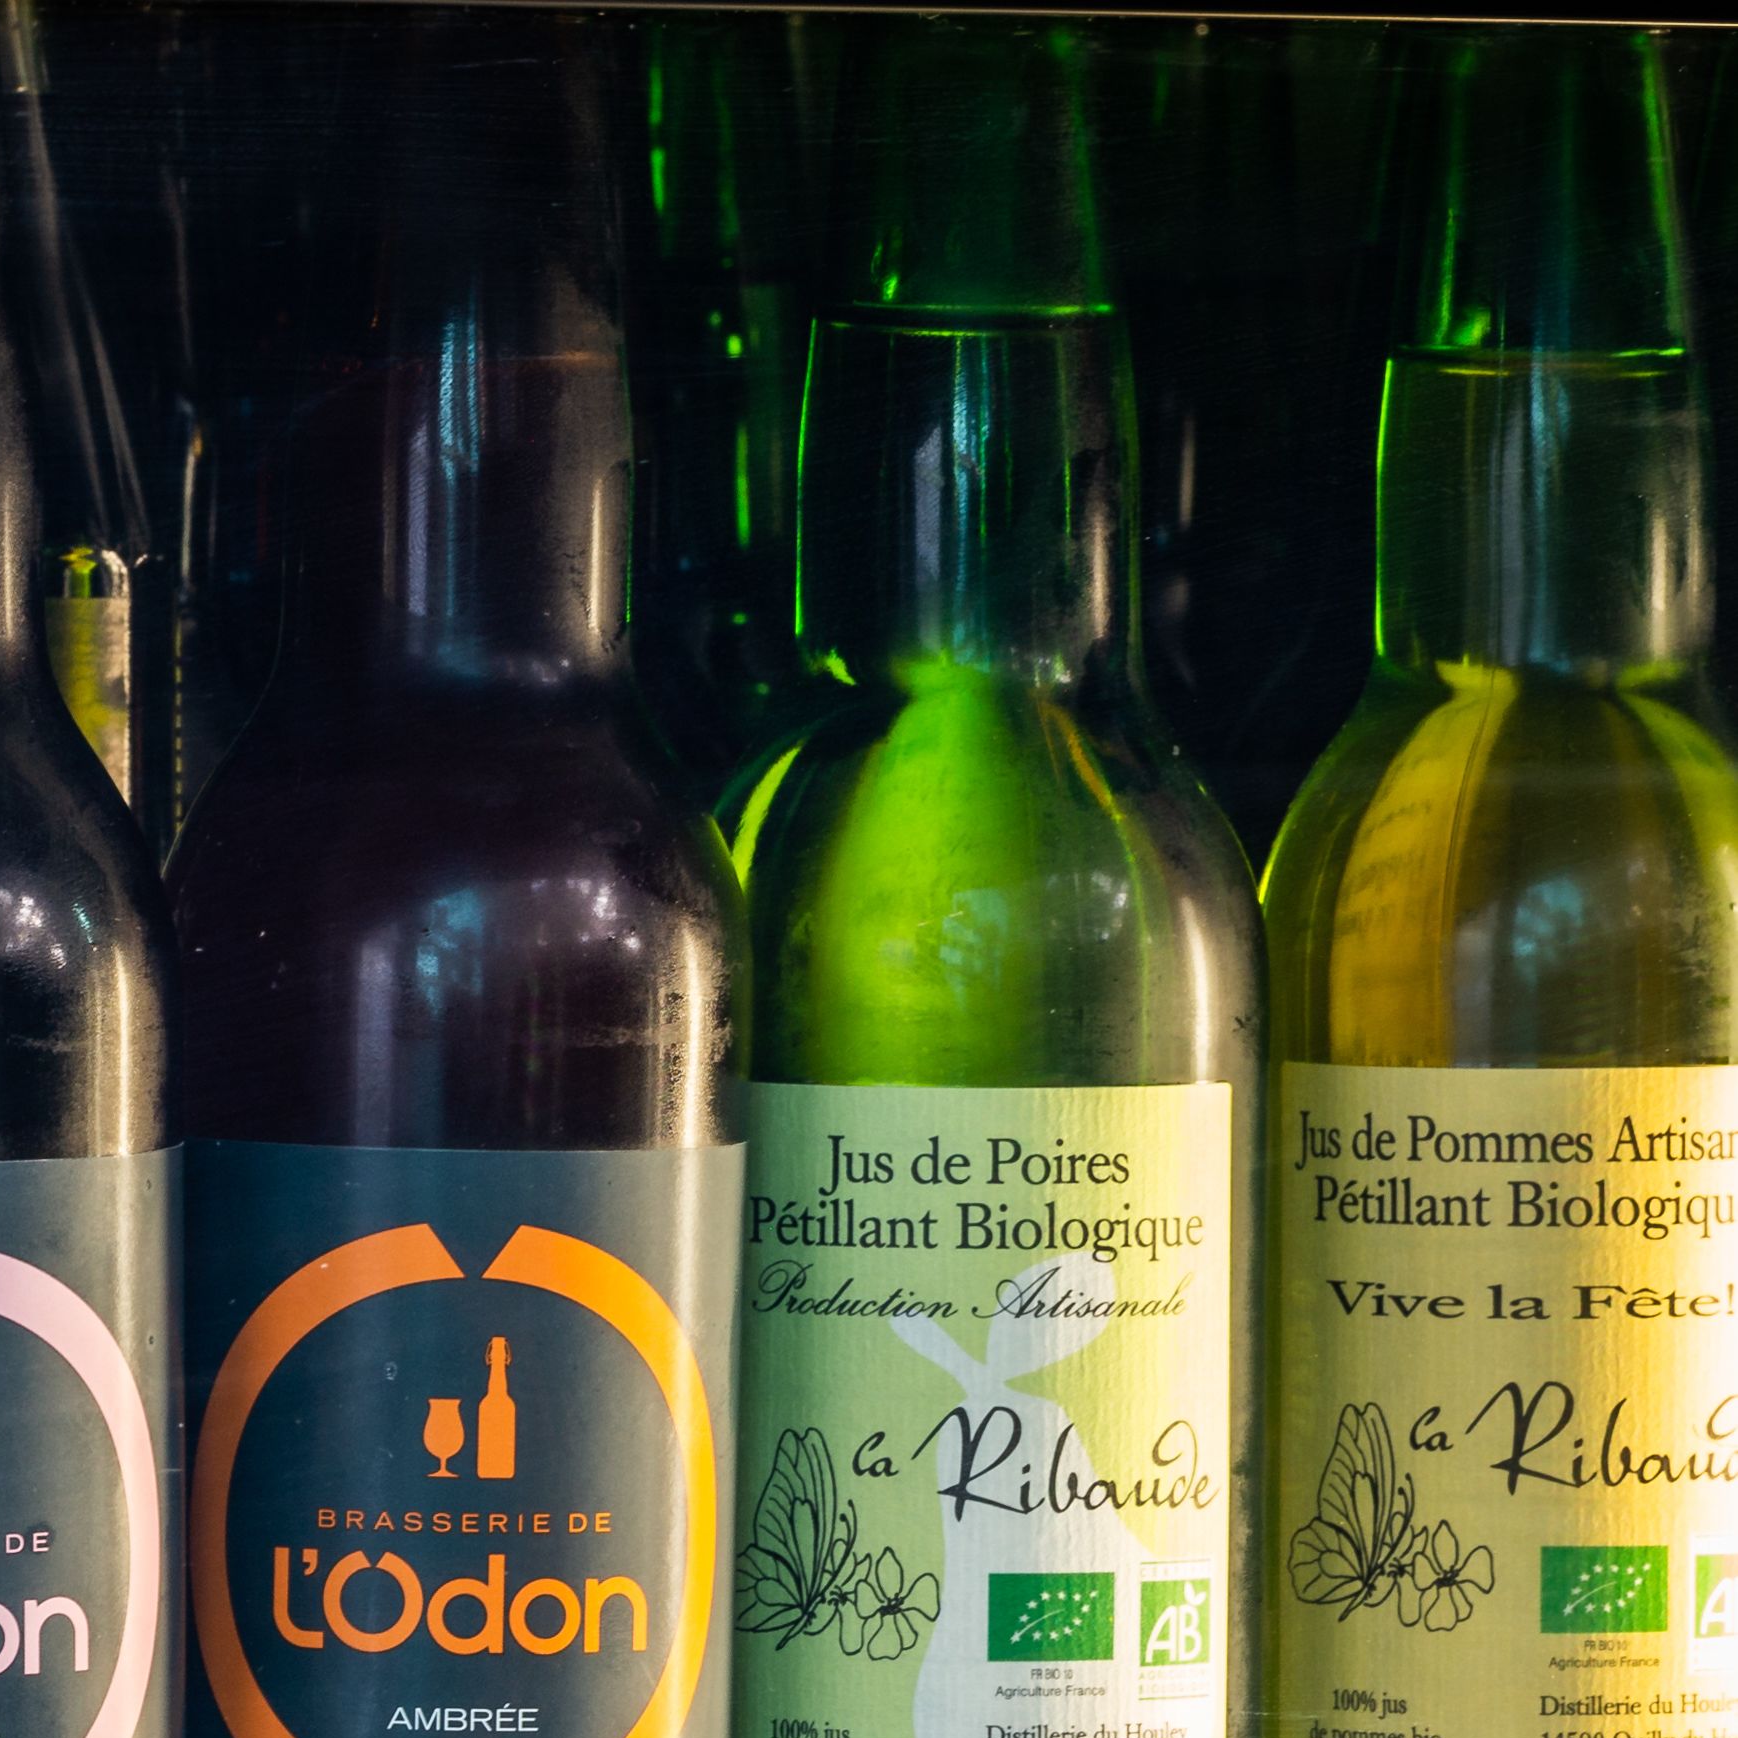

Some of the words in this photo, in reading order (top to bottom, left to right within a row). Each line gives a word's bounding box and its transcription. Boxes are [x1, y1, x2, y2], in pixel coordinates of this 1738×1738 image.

[1295, 1110, 1341, 1170] Jus
[1352, 1112, 1396, 1161] de
[1407, 1114, 1594, 1164] Pommes
[818, 1135, 894, 1197] Jus
[911, 1135, 971, 1184] de
[987, 1138, 1129, 1185] Poires
[1314, 1175, 1490, 1227] Pétillant
[1507, 1180, 1735, 1241] Biologiqu
[749, 1196, 939, 1249] Pétillant
[955, 1201, 1203, 1263] Biologique
[753, 1259, 958, 1319] Production
[971, 1266, 1196, 1320] Artisanale
[1326, 1280, 1465, 1319] Vive
[1487, 1284, 1550, 1320] la
[1572, 1284, 1735, 1320] Fête!
[911, 1405, 1221, 1523] Ribaude
[317, 1508, 551, 1533] BRASSERIE
[569, 1511, 611, 1533] DE
[5, 1531, 50, 1554] DE
[1145, 1603, 1205, 1664] AB
[1549, 1656, 1617, 1671] Agriculture
[1620, 1656, 1660, 1668] France
[995, 1686, 1062, 1700] Agriculture
[1065, 1685, 1106, 1698] France
[1332, 1688, 1376, 1714] 100%
[1378, 1691, 1407, 1719] jus
[1539, 1695, 1641, 1717] Distillerie
[1649, 1694, 1673, 1714] du
[387, 1701, 539, 1732] AMBRÉE
